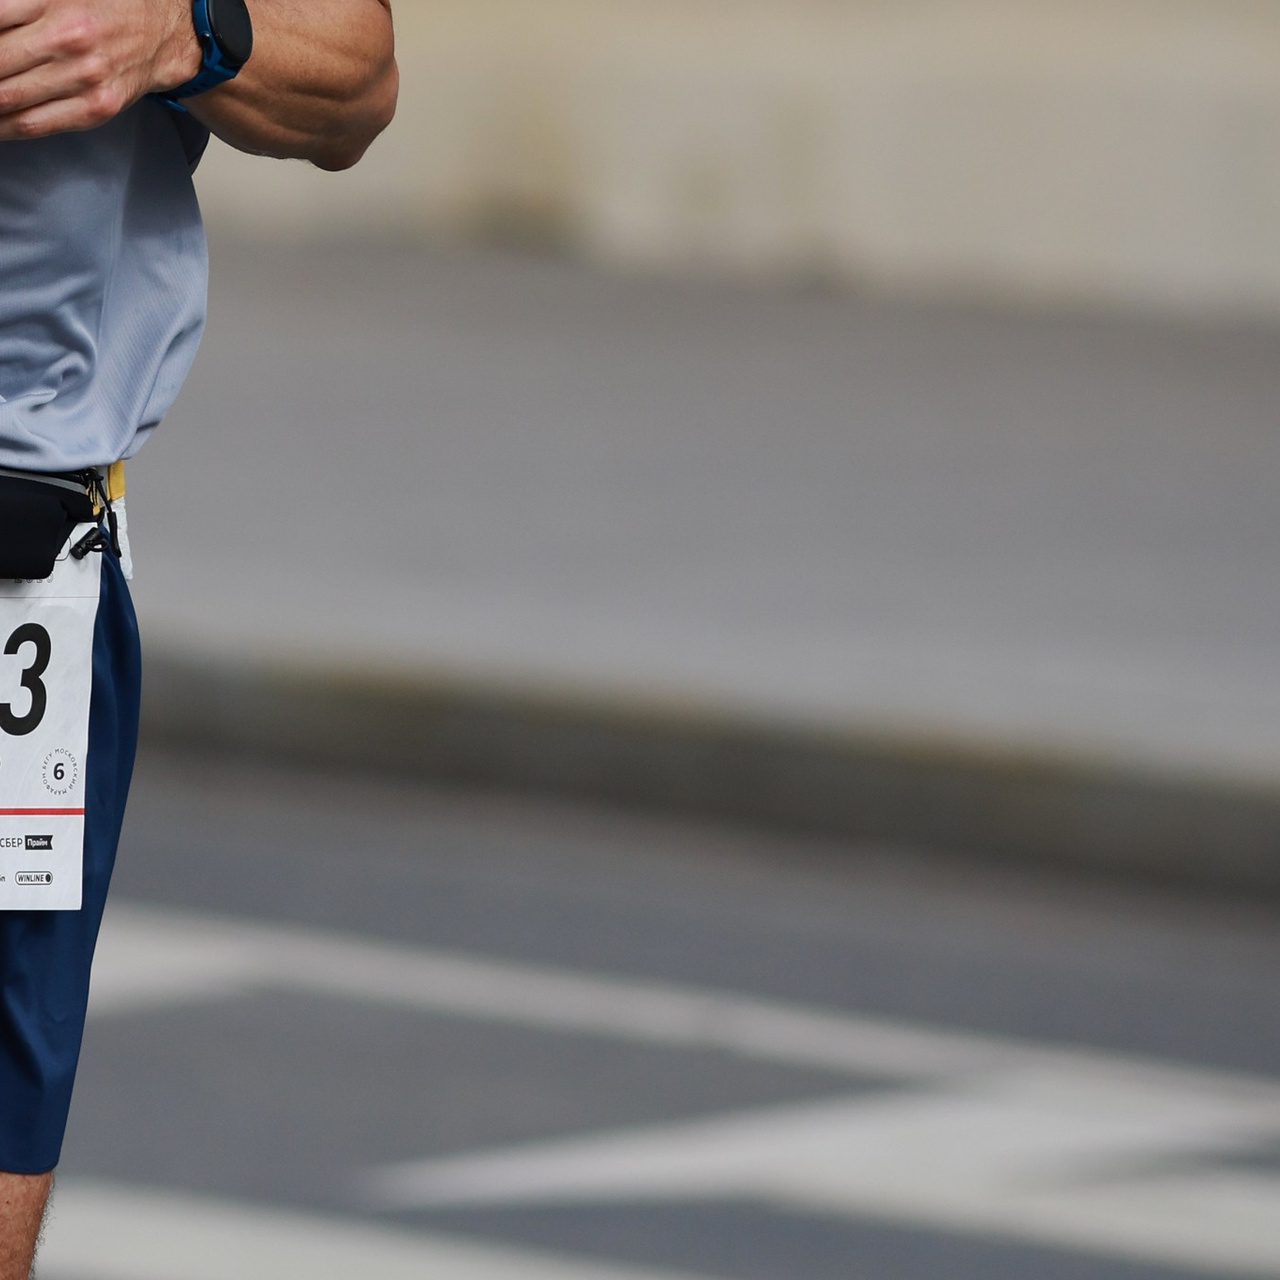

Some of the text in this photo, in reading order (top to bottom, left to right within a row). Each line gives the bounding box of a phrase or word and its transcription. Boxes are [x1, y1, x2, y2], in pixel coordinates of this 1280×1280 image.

[53, 762, 65, 780] 6
[0, 837, 23, 848] СБЕР
[27, 838, 48, 848] Прайм
[18, 874, 45, 883] WINLINE
